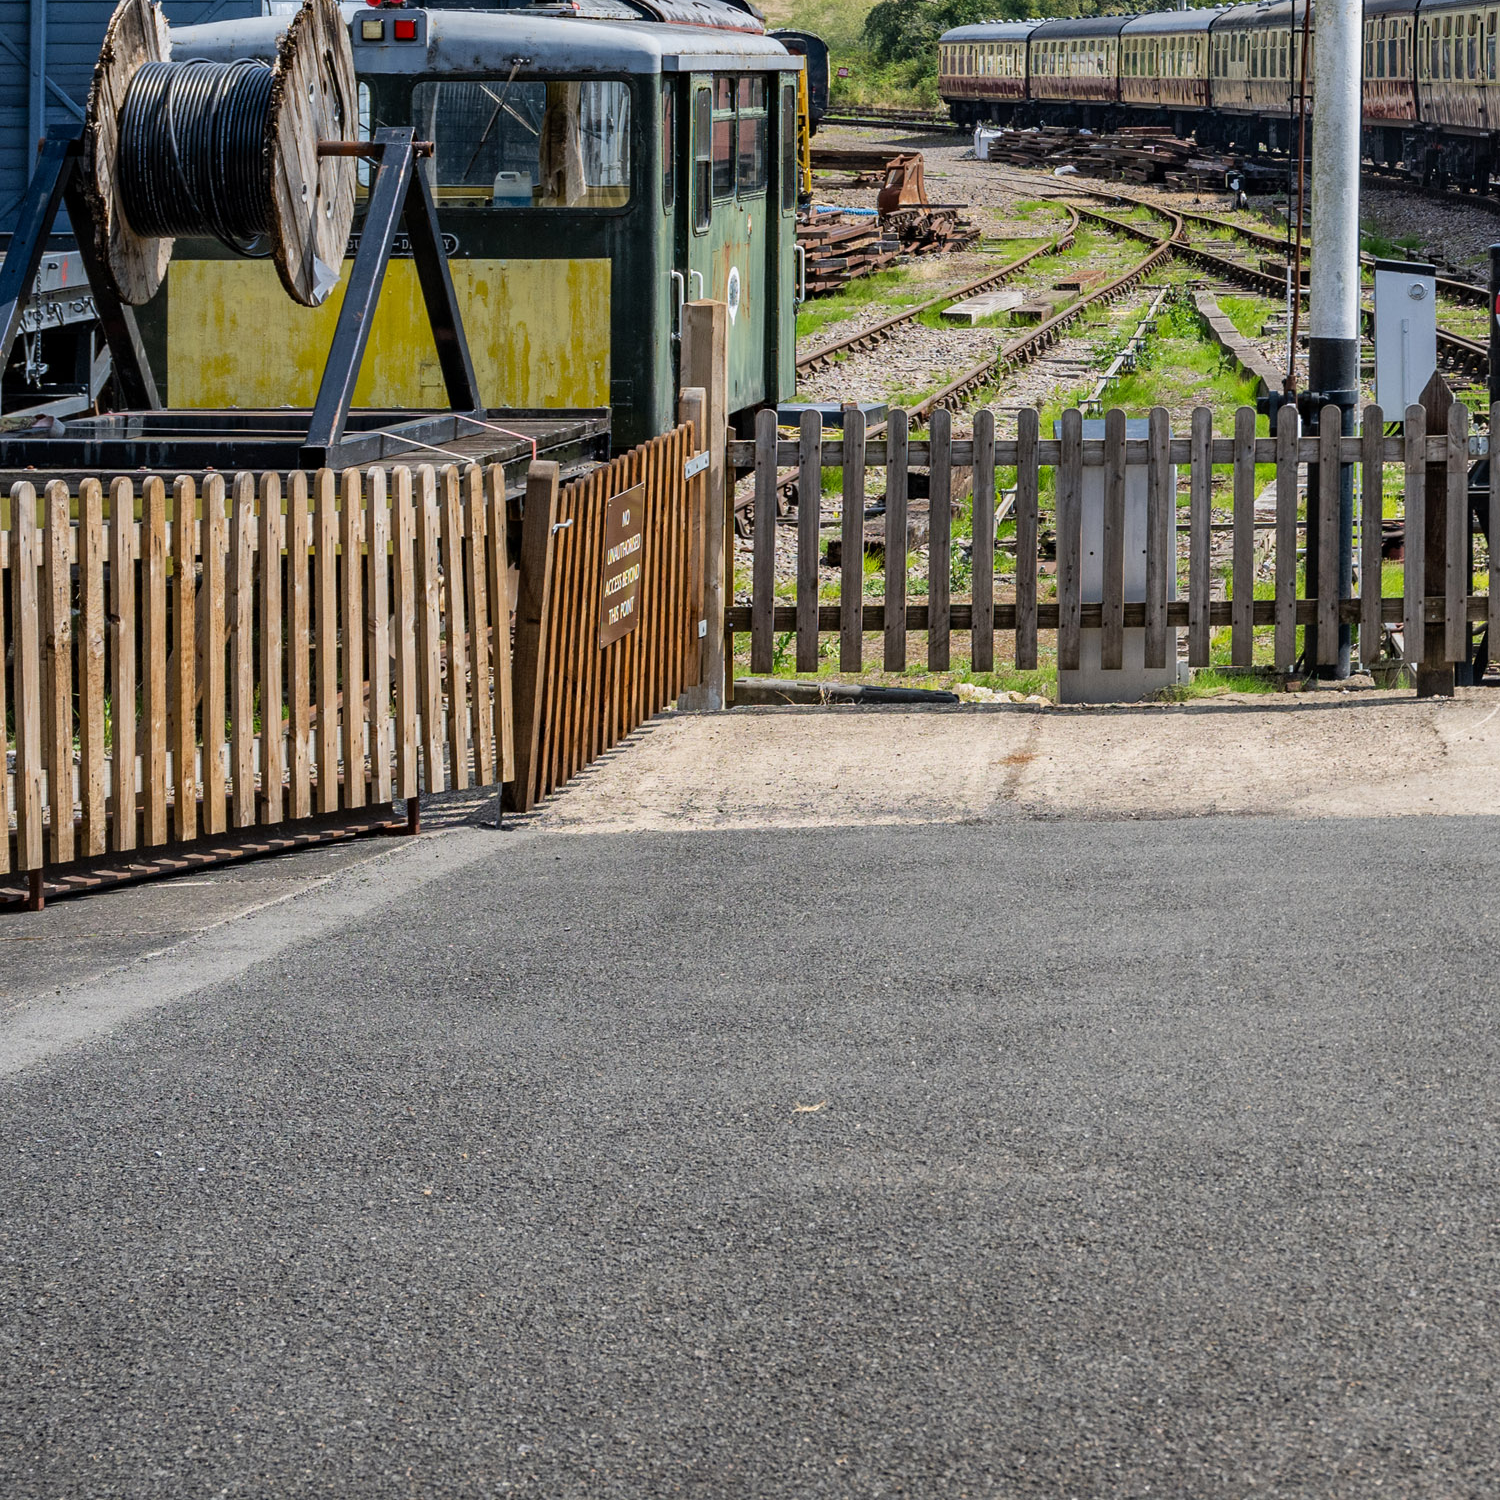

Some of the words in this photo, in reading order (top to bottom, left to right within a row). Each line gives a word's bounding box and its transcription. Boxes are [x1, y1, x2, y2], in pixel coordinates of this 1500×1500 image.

[621, 508, 631, 528] NO
[607, 533, 641, 566] UNAUTHORISED
[604, 573, 622, 598] ACCESS
[621, 563, 640, 589] BEYOND
[608, 604, 620, 626] THIS
[620, 596, 635, 620] POINT
